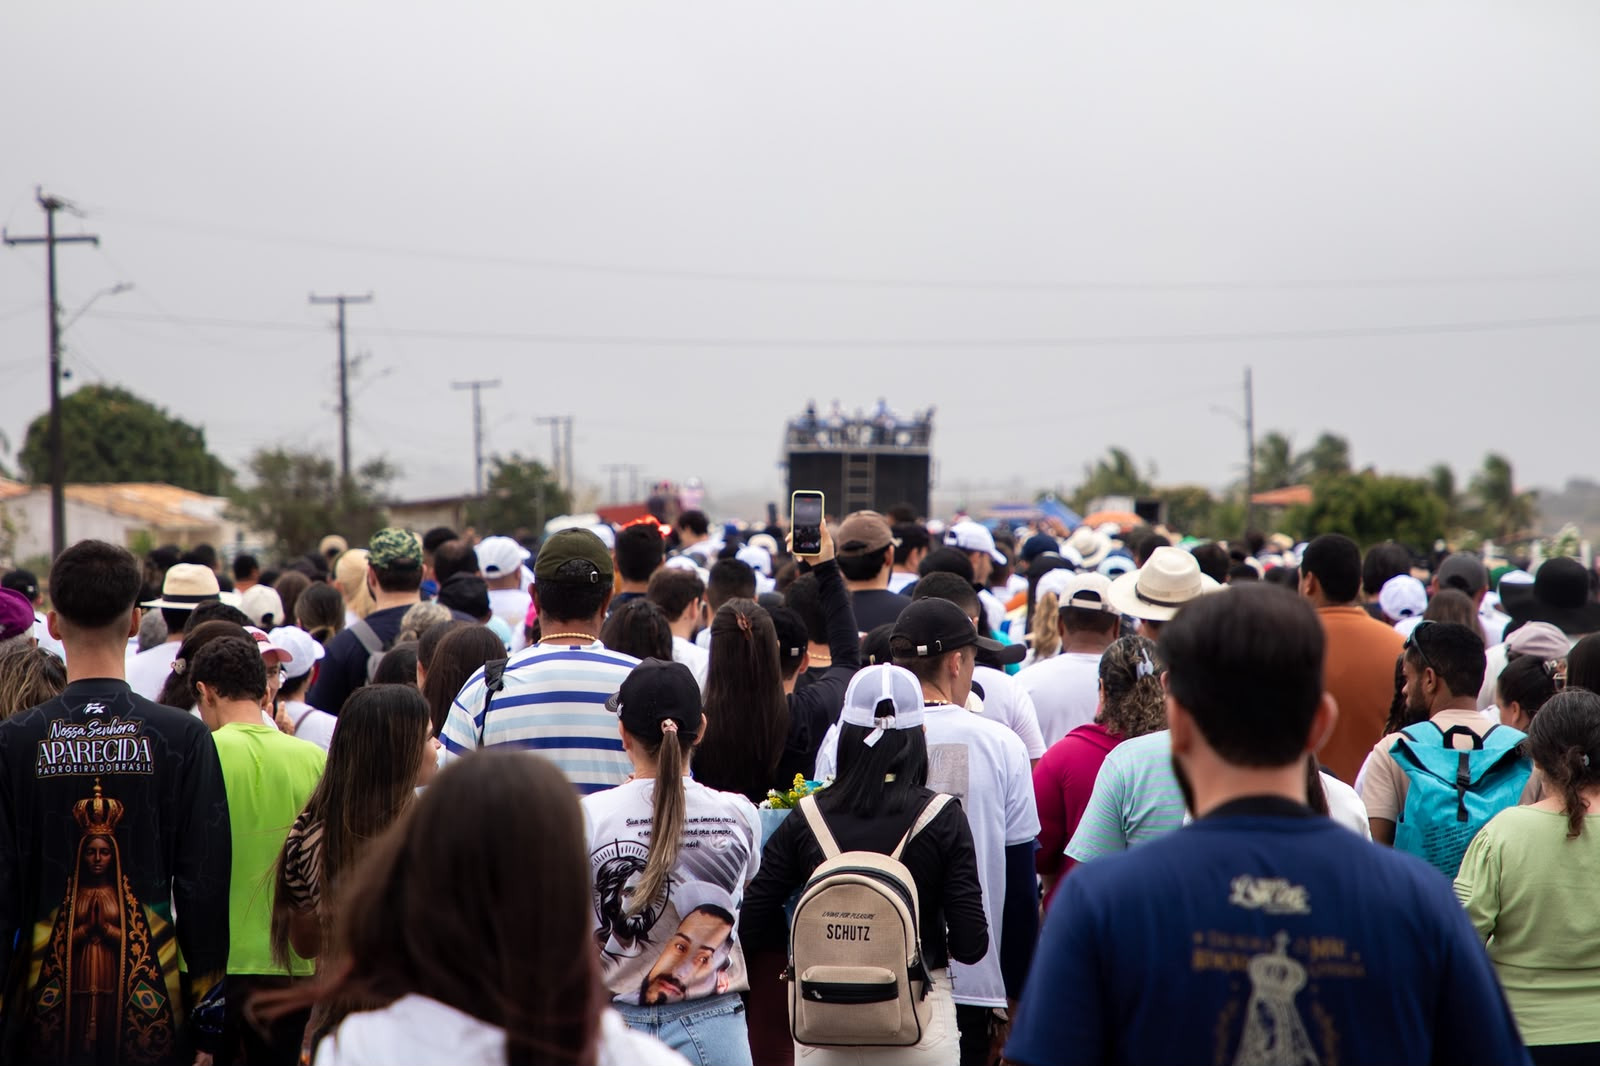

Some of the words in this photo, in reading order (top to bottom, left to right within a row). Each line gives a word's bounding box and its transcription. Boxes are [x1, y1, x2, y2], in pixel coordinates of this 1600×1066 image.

[50, 721, 87, 739] Nossa
[87, 717, 137, 739] Senhora
[39, 738, 151, 766] APARECIDA
[38, 764, 96, 775] PADROEIRA
[99, 764, 112, 773] DO
[115, 763, 152, 773] BRASIL
[827, 924, 870, 941] SCHUTZ
